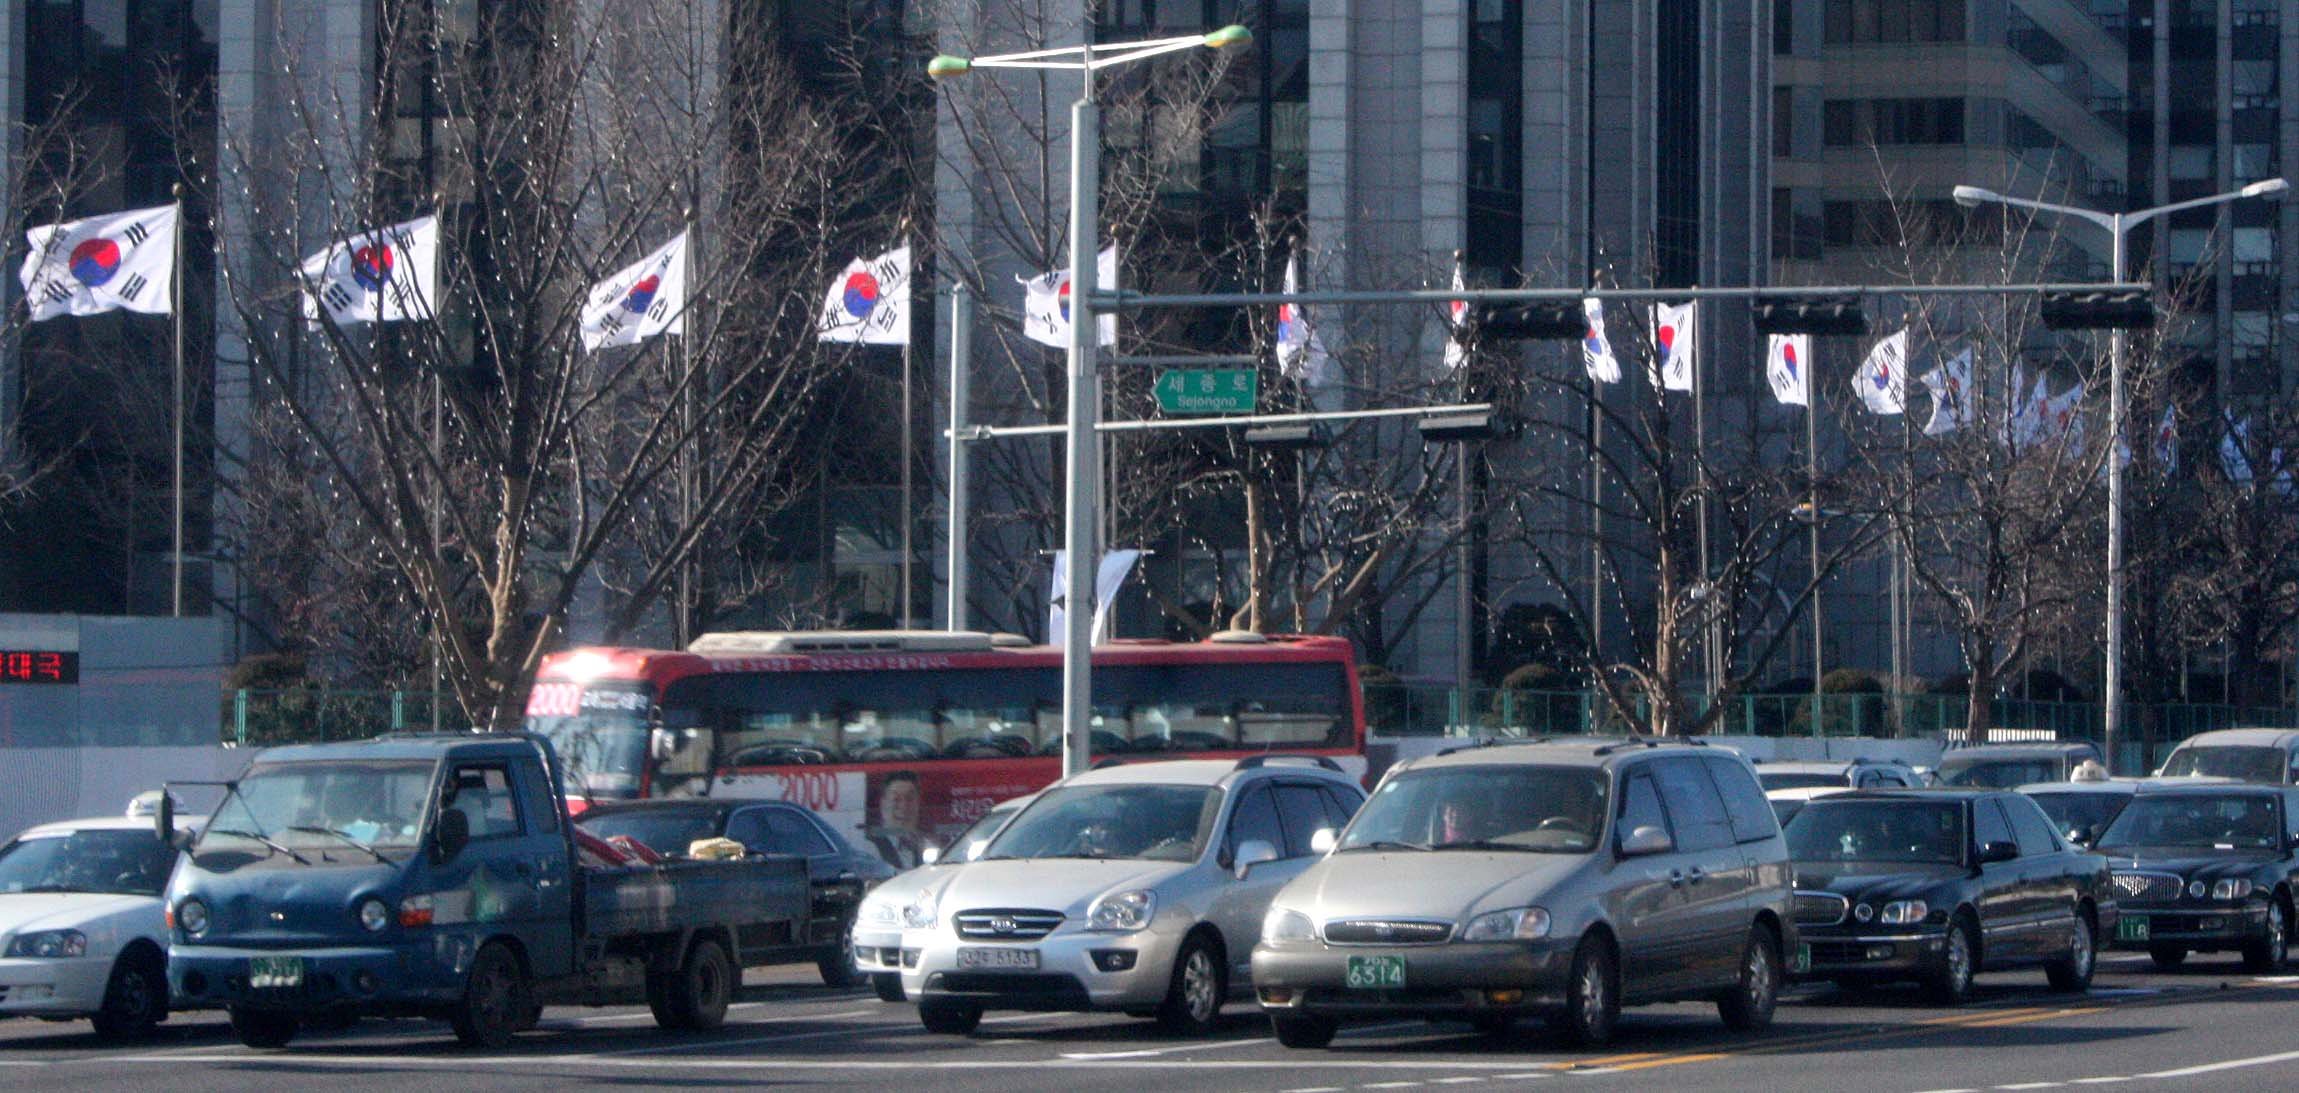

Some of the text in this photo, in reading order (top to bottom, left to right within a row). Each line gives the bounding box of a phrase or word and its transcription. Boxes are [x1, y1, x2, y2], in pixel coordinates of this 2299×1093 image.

[1178, 396, 1237, 408] Sejongno
[527, 682, 579, 715] 2000
[779, 772, 838, 810] 2000
[1350, 965, 1402, 985] 6314
